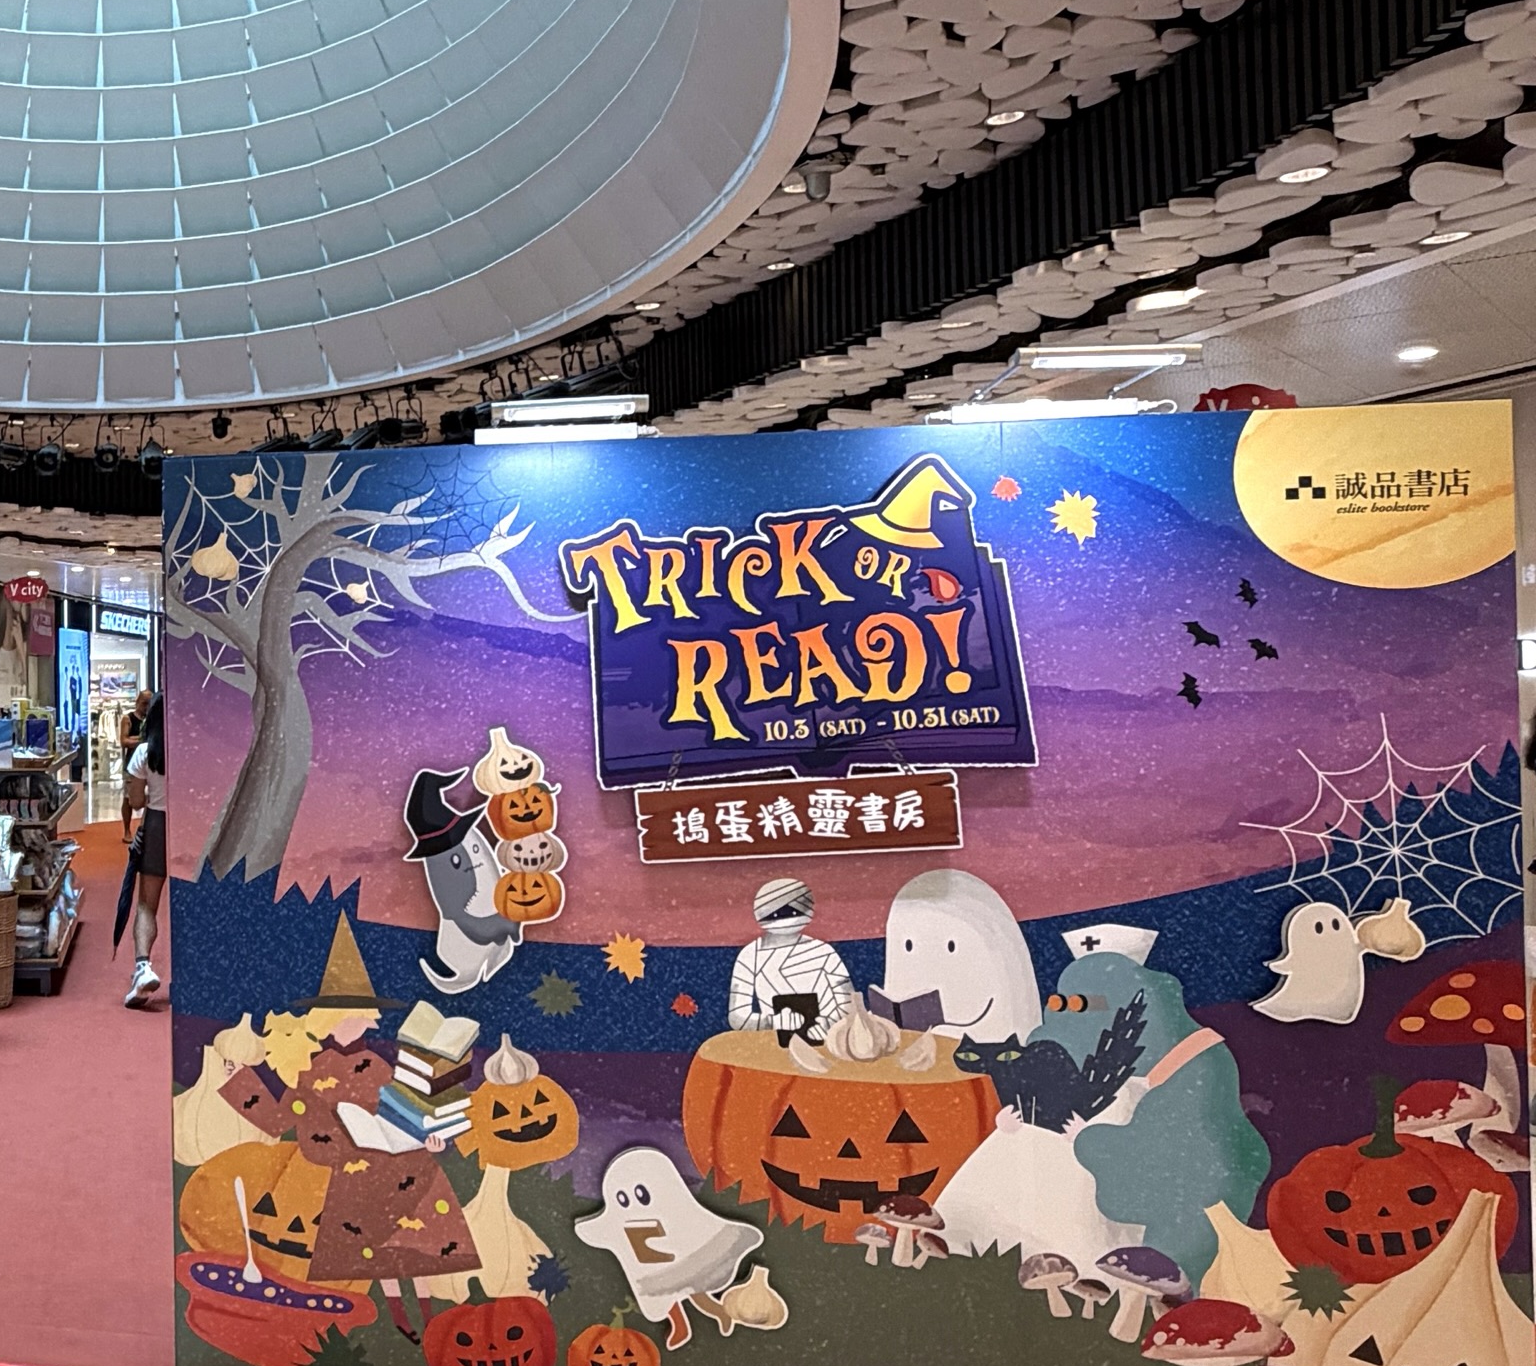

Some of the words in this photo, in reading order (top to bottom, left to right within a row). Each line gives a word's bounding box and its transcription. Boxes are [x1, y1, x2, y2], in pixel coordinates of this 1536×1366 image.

[1335, 468, 1470, 499] 誠品書店
[1336, 503, 1368, 514] eslite
[1371, 501, 1430, 513] bookstore
[10, 584, 20, 598] V
[21, 582, 44, 597] city
[570, 517, 855, 634] TRICK
[854, 546, 912, 599] OR
[100, 610, 151, 636] SKECHERS
[667, 608, 972, 742] READ!
[764, 720, 811, 742] 10.3
[820, 718, 866, 738] (SAT)
[892, 706, 947, 730] 10.31
[951, 706, 1001, 726] (SAT)
[671, 789, 926, 845] 搗蛋精靈書房
